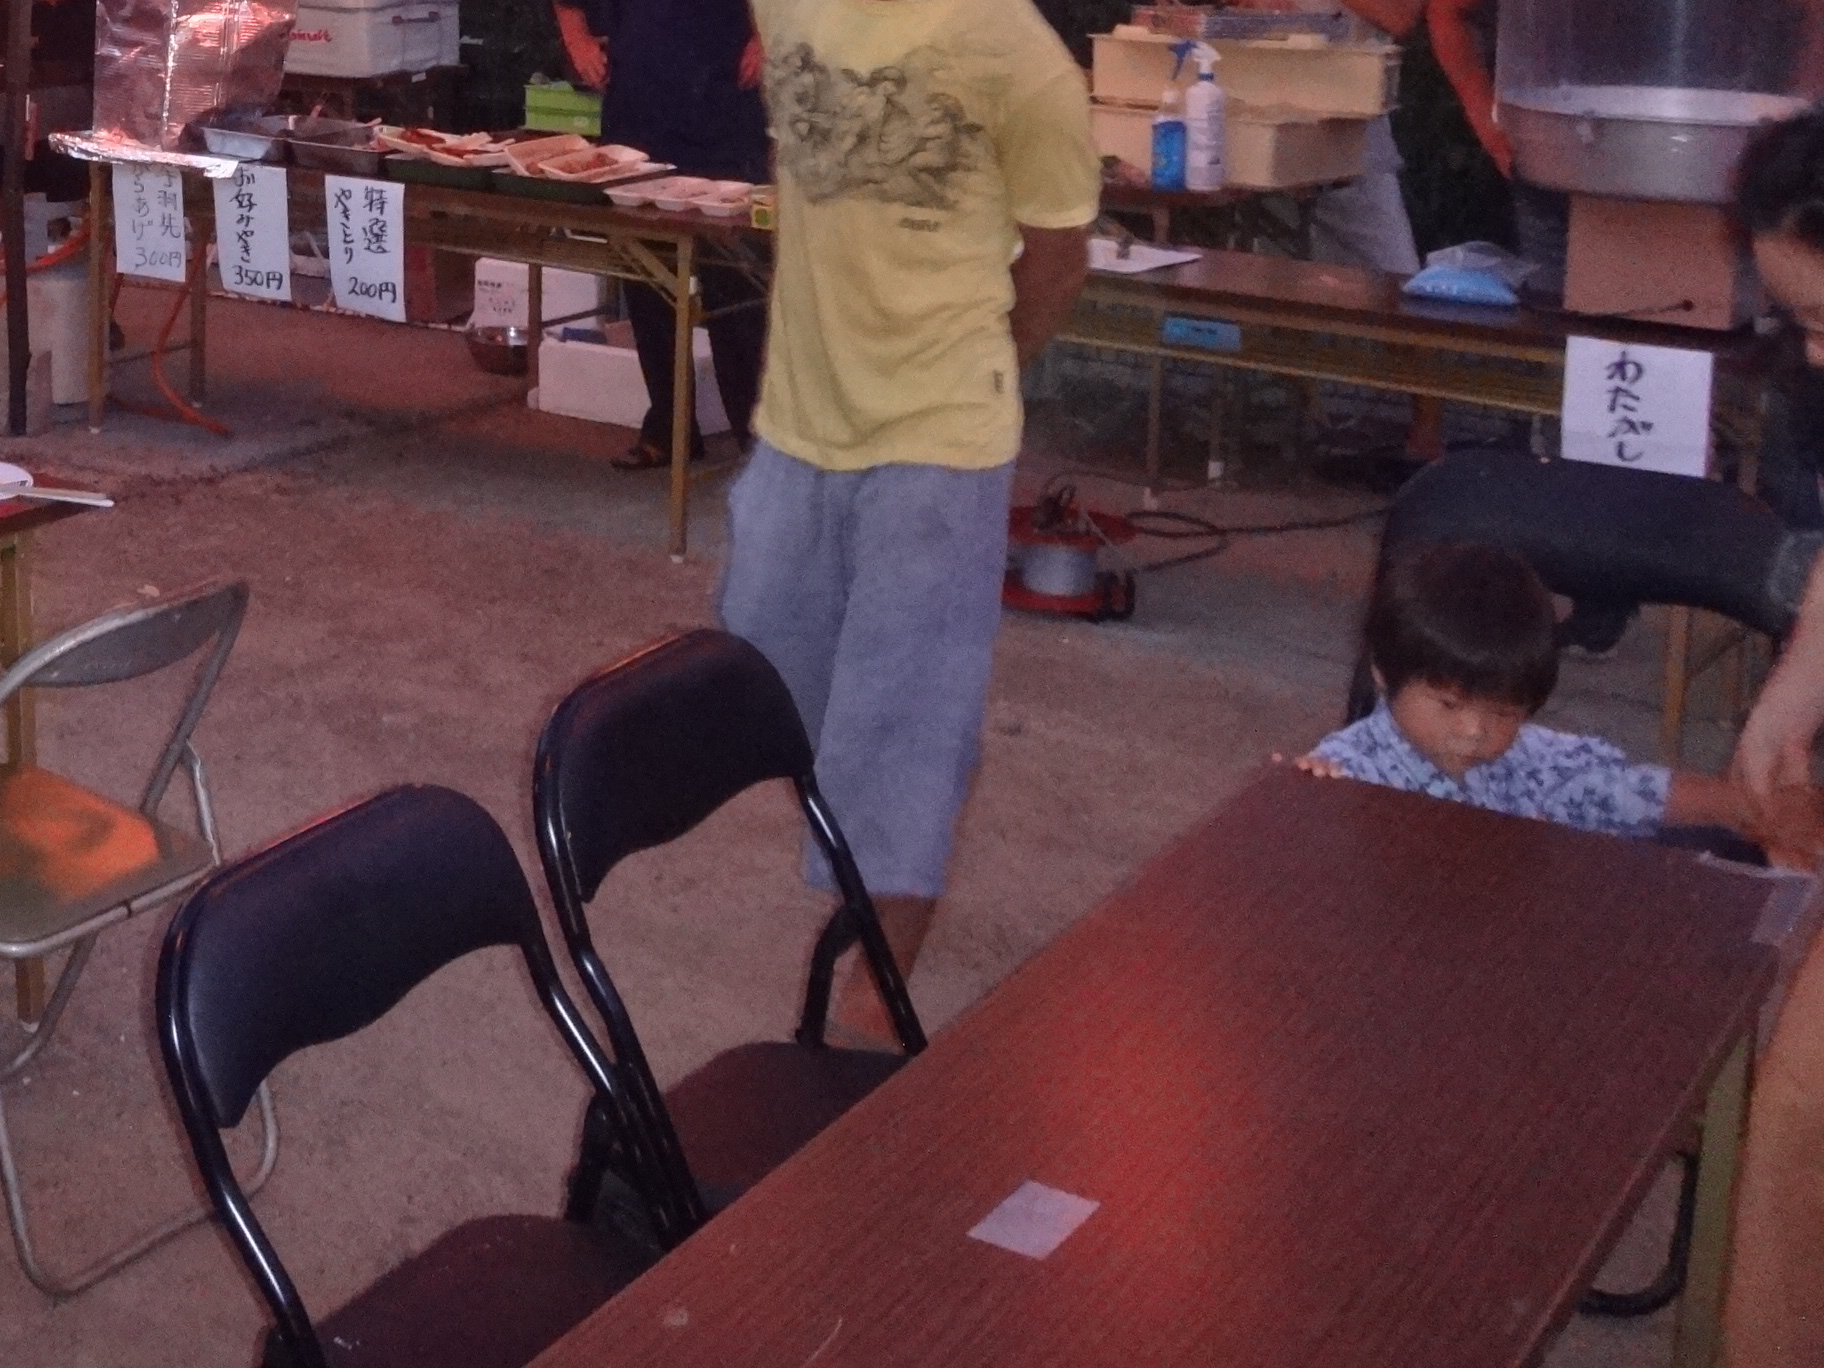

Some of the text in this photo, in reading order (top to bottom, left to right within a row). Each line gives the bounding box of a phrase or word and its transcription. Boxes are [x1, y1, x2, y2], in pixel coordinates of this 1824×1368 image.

[334, 187, 355, 264] やきとり
[135, 246, 182, 269] 300円
[233, 265, 283, 290] 350円
[348, 277, 396, 303] 200円
[1605, 350, 1654, 462] わたがし
